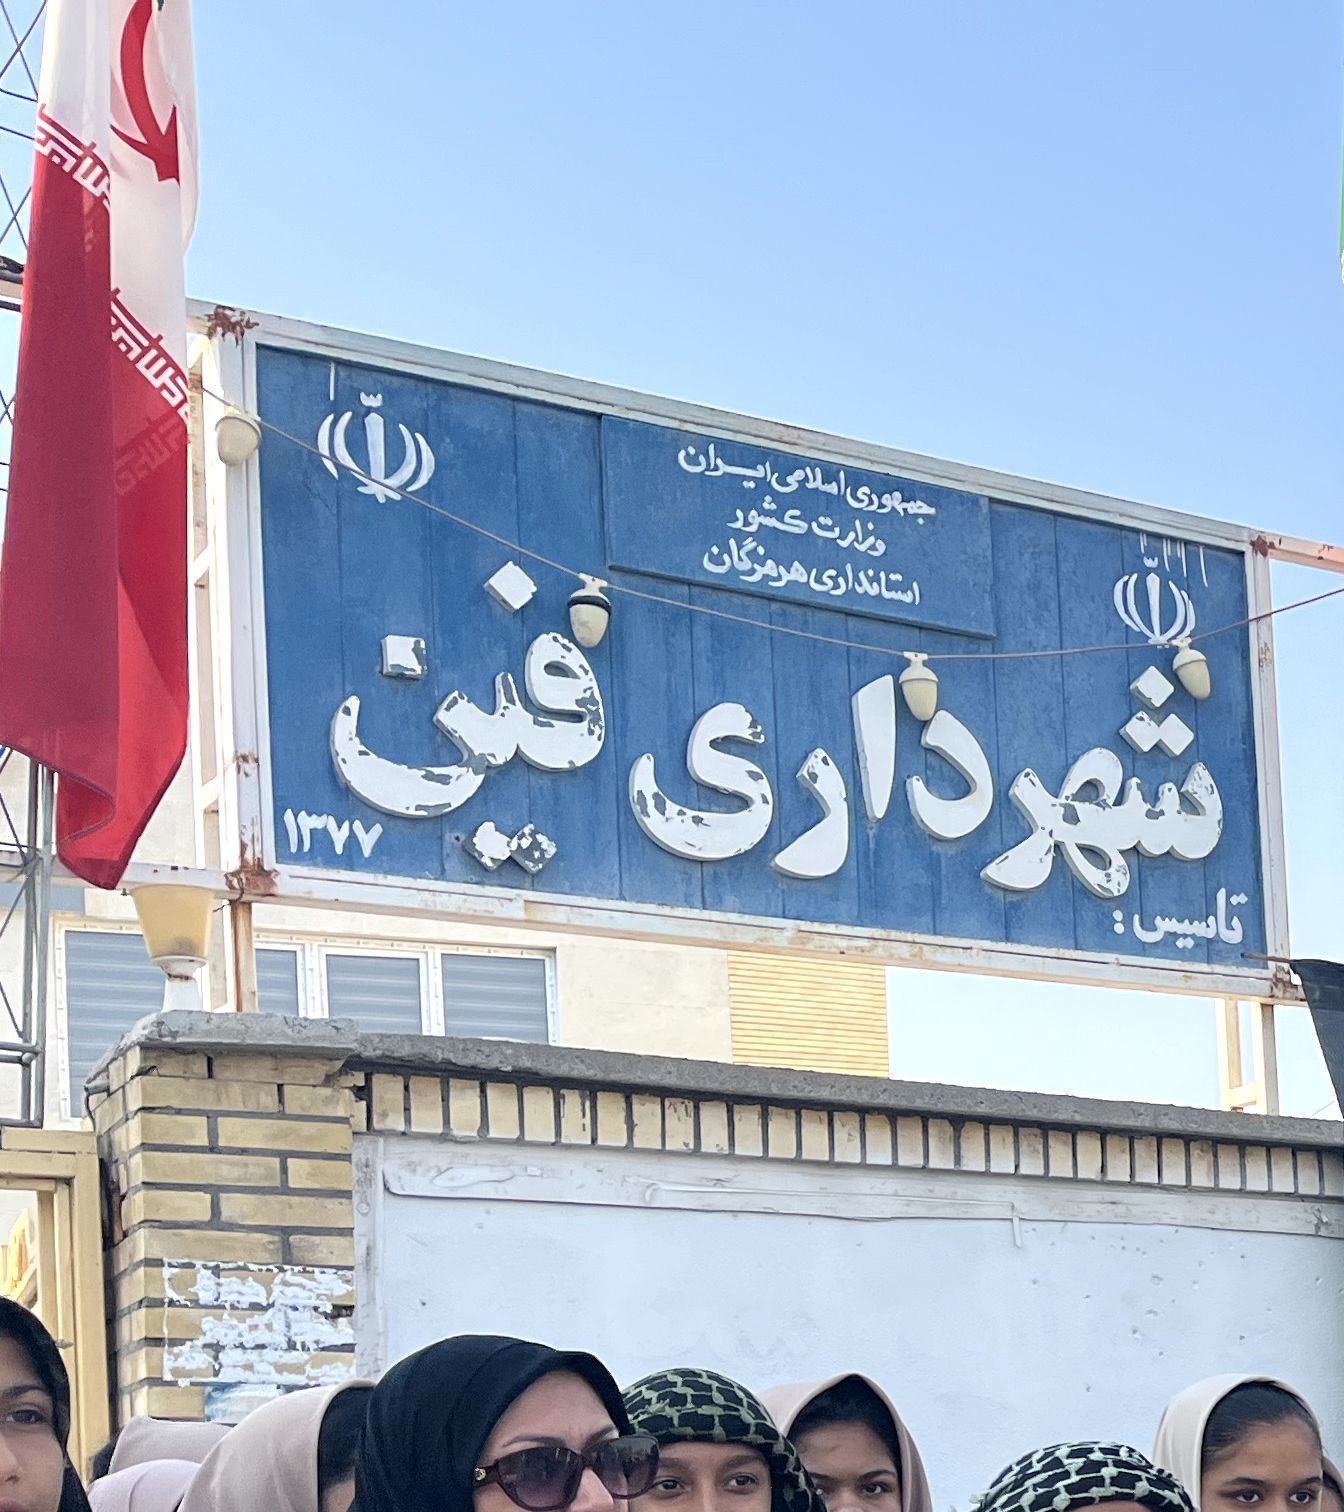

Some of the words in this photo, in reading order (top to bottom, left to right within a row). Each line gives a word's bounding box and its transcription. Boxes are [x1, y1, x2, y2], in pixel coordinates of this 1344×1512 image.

[678, 443, 771, 488] ایران
[771, 467, 846, 497] اسلامی
[727, 495, 808, 534] کشور
[846, 486, 936, 525] جمهوری
[811, 515, 887, 556] وزارت
[703, 537, 808, 587] هرمزگان
[809, 563, 921, 605] استانداری
[330, 562, 604, 874] فین
[629, 665, 1222, 900] شهرداری
[283, 808, 383, 858] ۱۳۷۷
